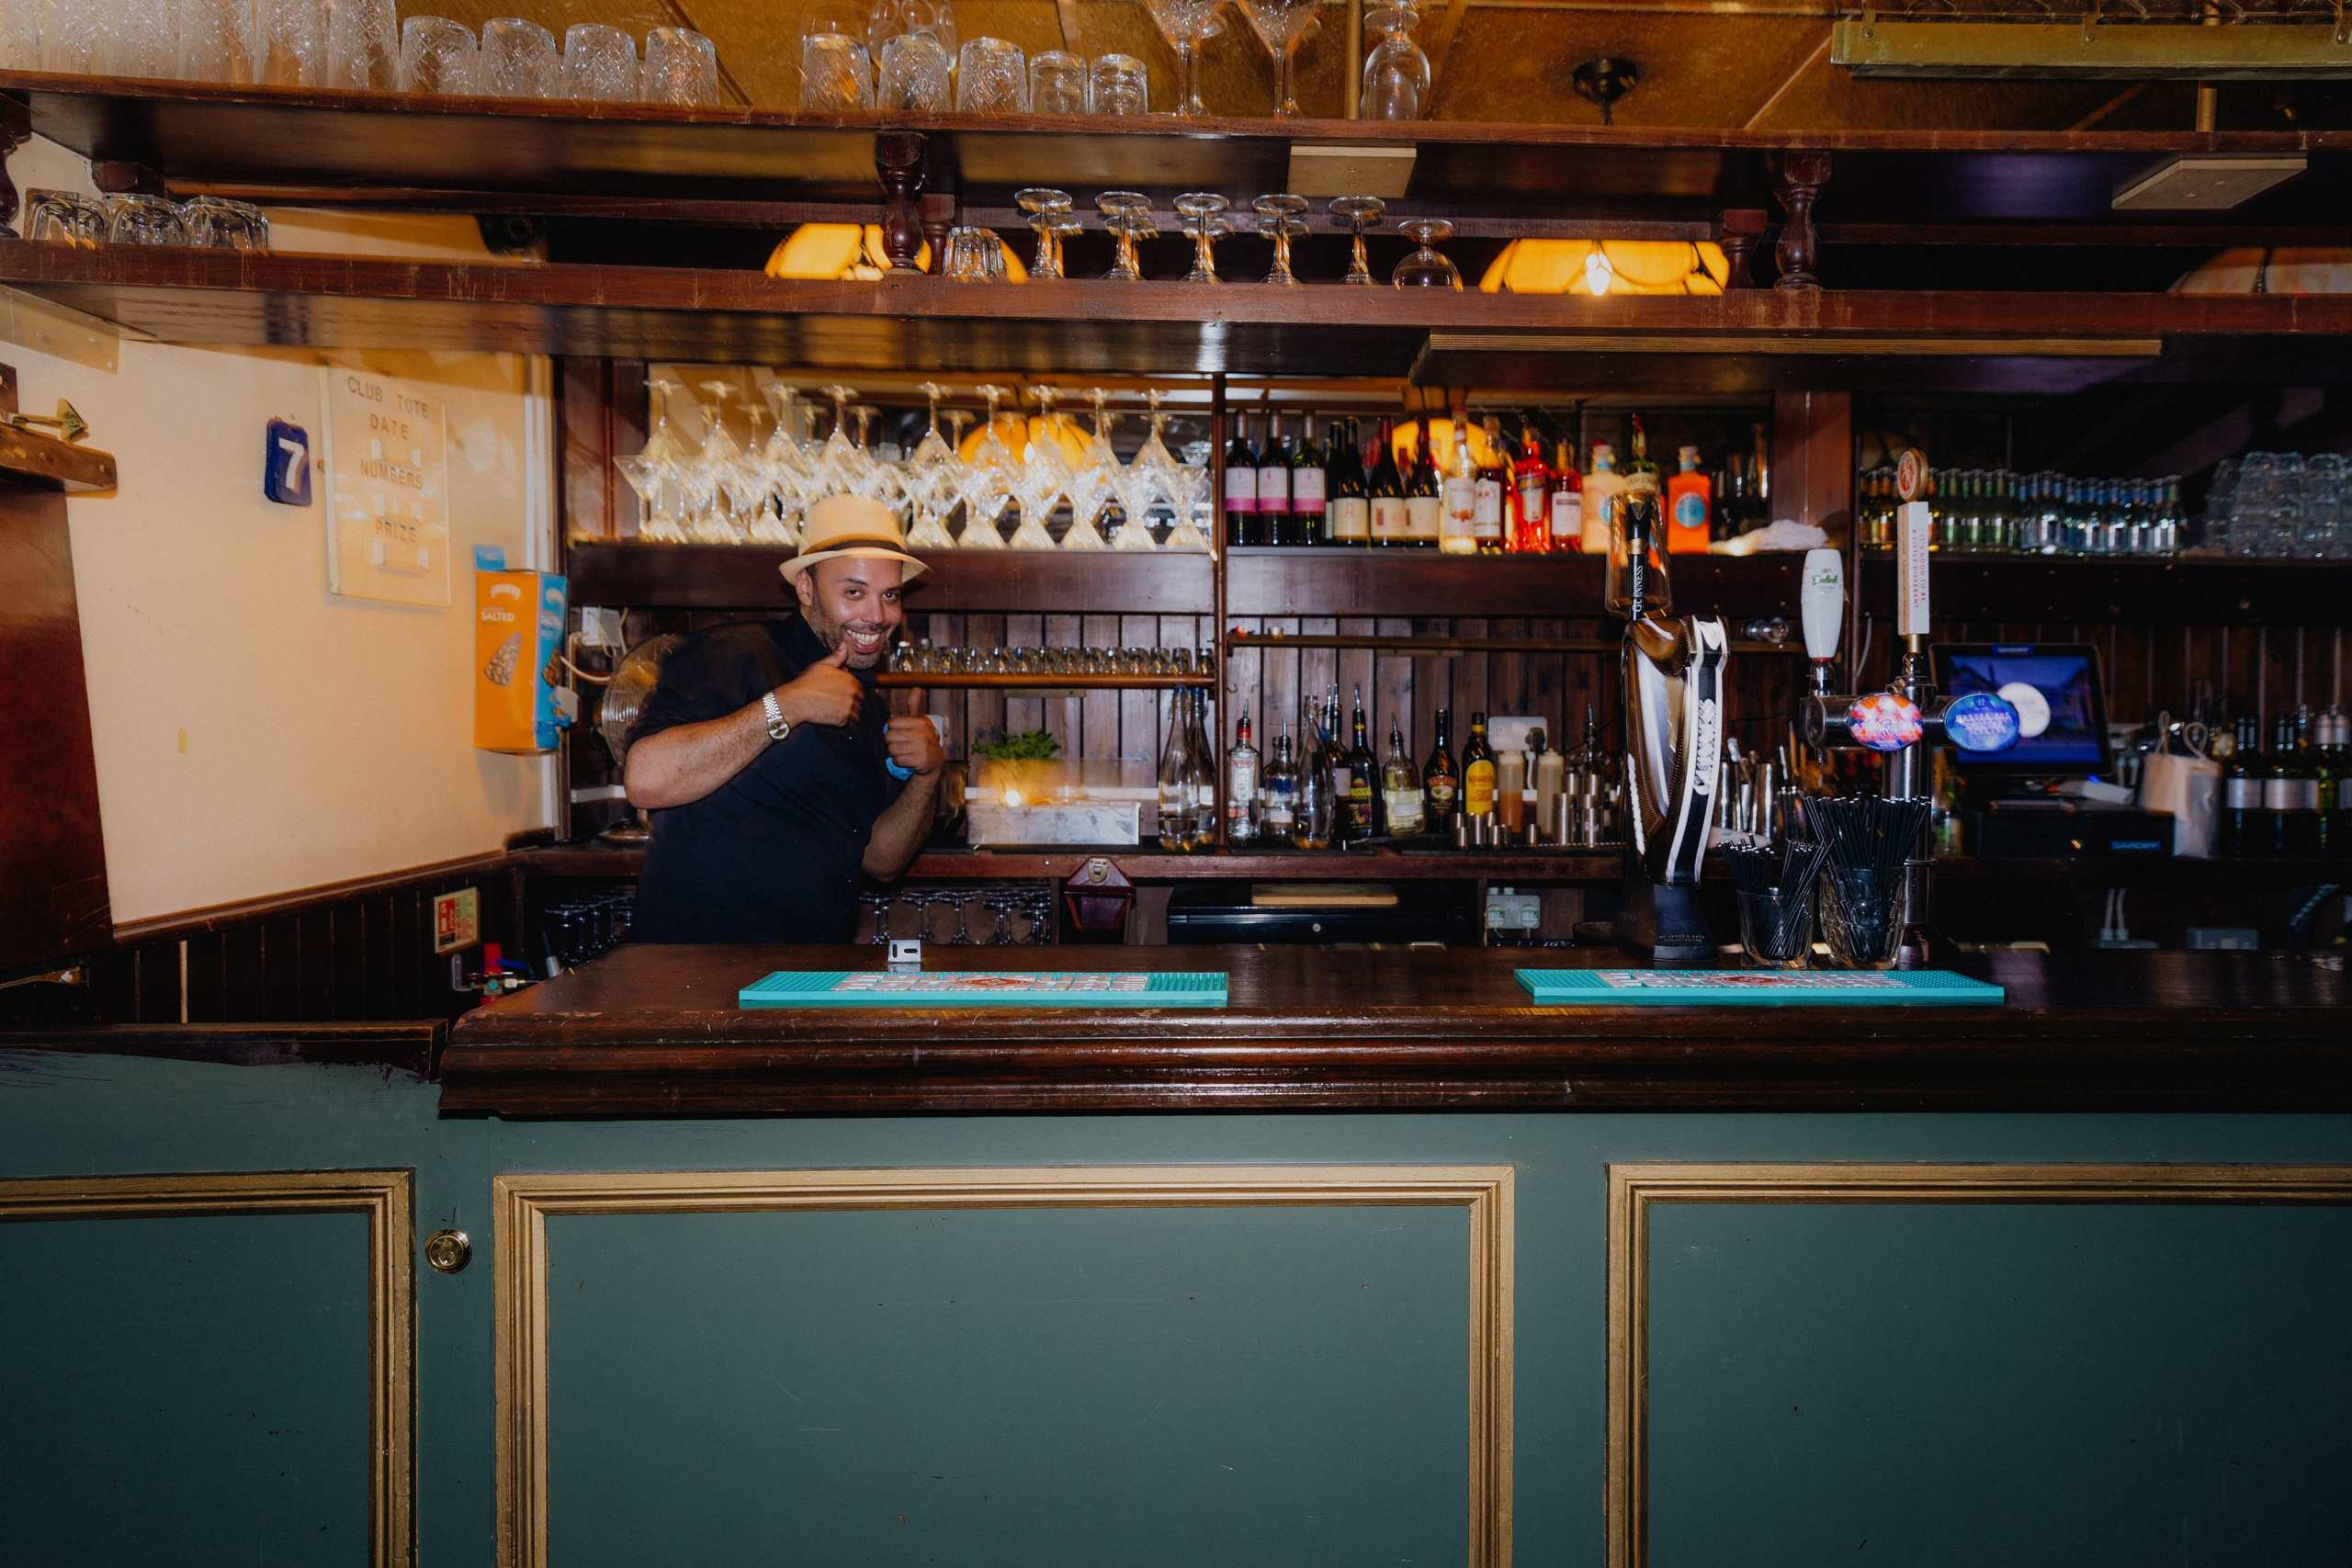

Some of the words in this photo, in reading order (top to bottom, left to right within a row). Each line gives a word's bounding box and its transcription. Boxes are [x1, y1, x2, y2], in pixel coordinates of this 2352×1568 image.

[347, 376, 383, 403] CLUB
[397, 393, 429, 419] TOTE
[369, 412, 408, 440] DATE
[278, 436, 305, 490] 7
[359, 459, 423, 490] NUMBERS
[374, 518, 416, 544] PRIZE
[1632, 565, 1644, 613] GUINNESS
[1920, 579, 1927, 590] TO
[1920, 592, 1927, 602] BE
[481, 611, 515, 622] SALTED
